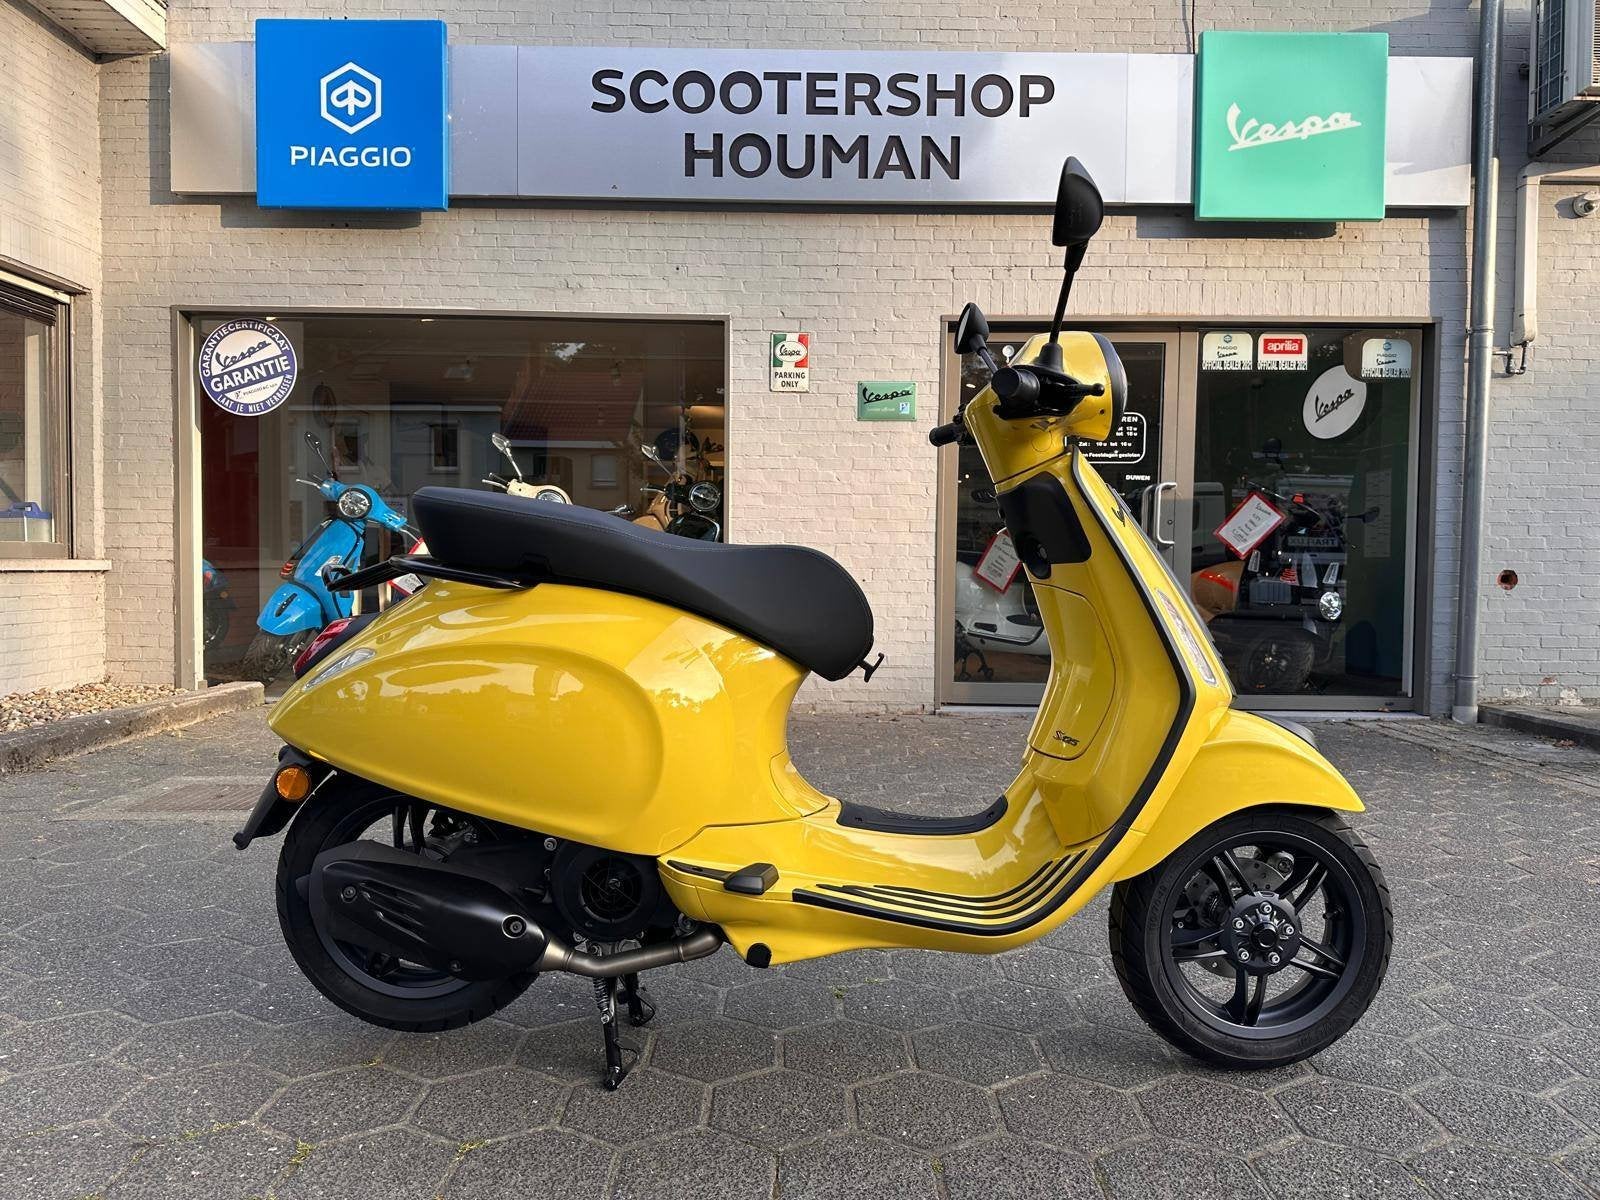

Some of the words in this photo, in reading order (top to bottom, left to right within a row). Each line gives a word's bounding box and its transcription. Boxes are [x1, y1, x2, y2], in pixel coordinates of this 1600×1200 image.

[591, 69, 1055, 117] SCOOTERSHOP
[1226, 102, 1362, 151] Vespa
[290, 145, 412, 167] PIAGGIO
[684, 132, 961, 180] HOUMAN
[202, 320, 290, 377] GARANTIECERTIFICAAT
[215, 340, 272, 371] Vespa
[779, 344, 801, 357] Vespa
[1267, 340, 1300, 353] aprilia
[210, 356, 291, 392] GARANTIE
[774, 371, 806, 380] PARKING
[781, 380, 799, 388] ONLY
[216, 394, 234, 408] LAAT
[236, 403, 245, 413] JE
[248, 402, 266, 413] NIET
[267, 373, 293, 408] VERRASSEN
[862, 386, 913, 405] Vespa
[1315, 388, 1355, 423] Vespa
